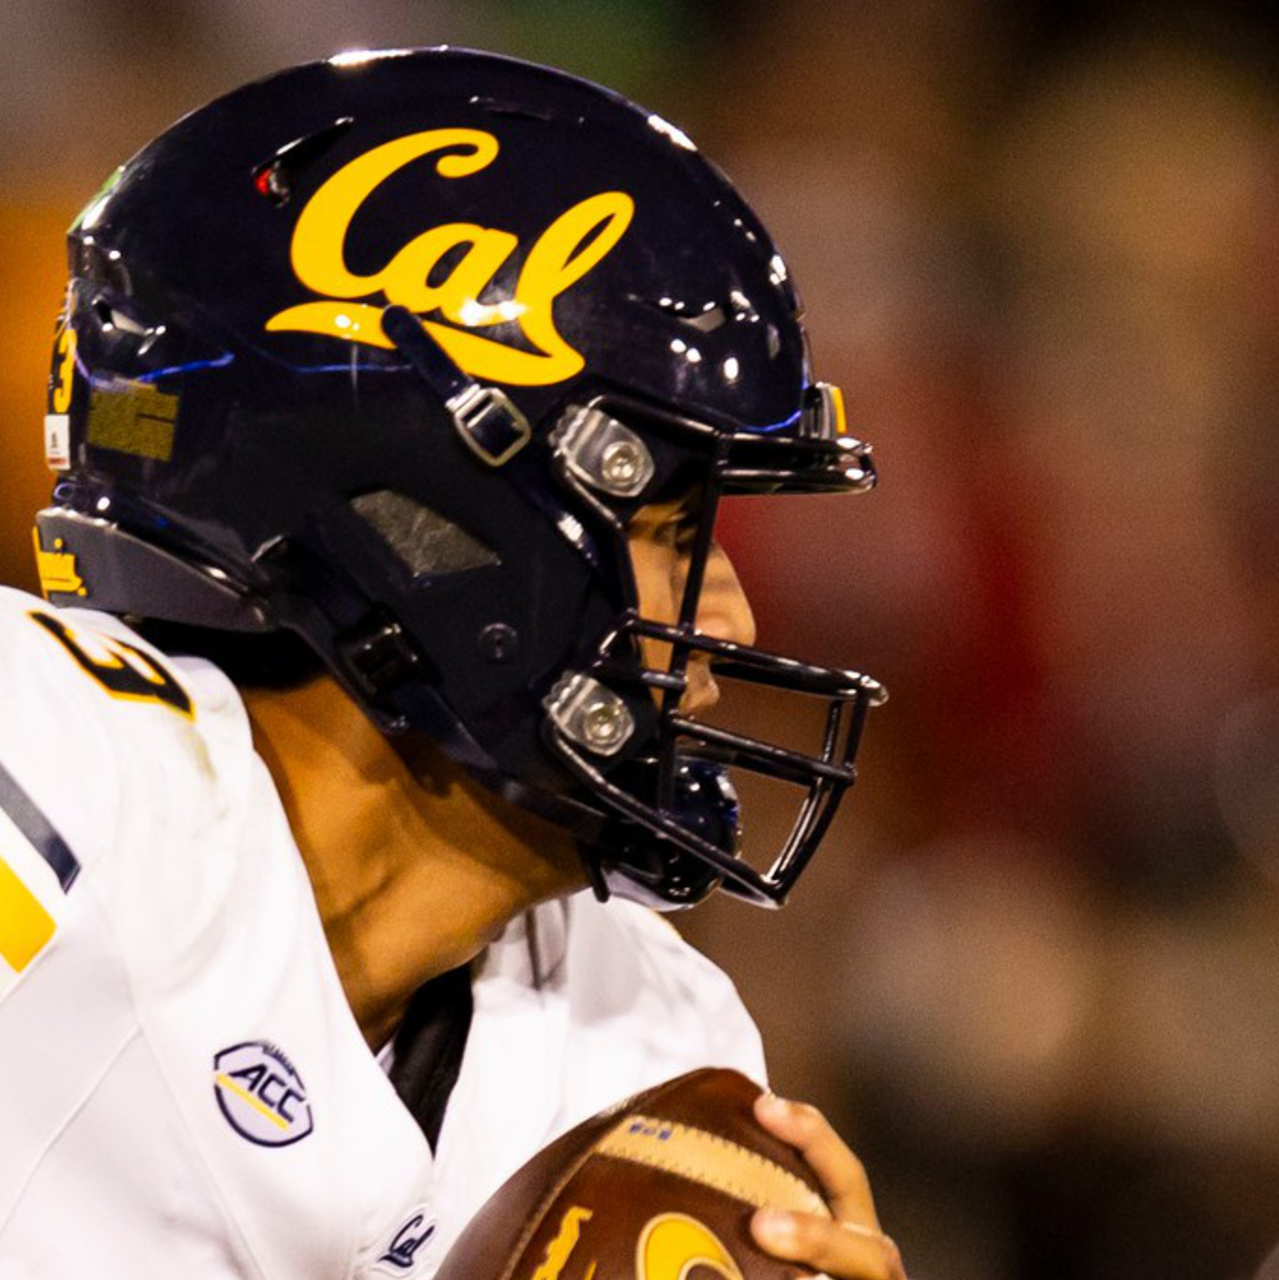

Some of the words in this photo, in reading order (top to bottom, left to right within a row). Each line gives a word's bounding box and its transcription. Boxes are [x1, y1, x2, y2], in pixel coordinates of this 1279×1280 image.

[266, 127, 635, 387] Cal
[228, 1063, 306, 1123] ACC
[375, 1213, 436, 1269] Cal
